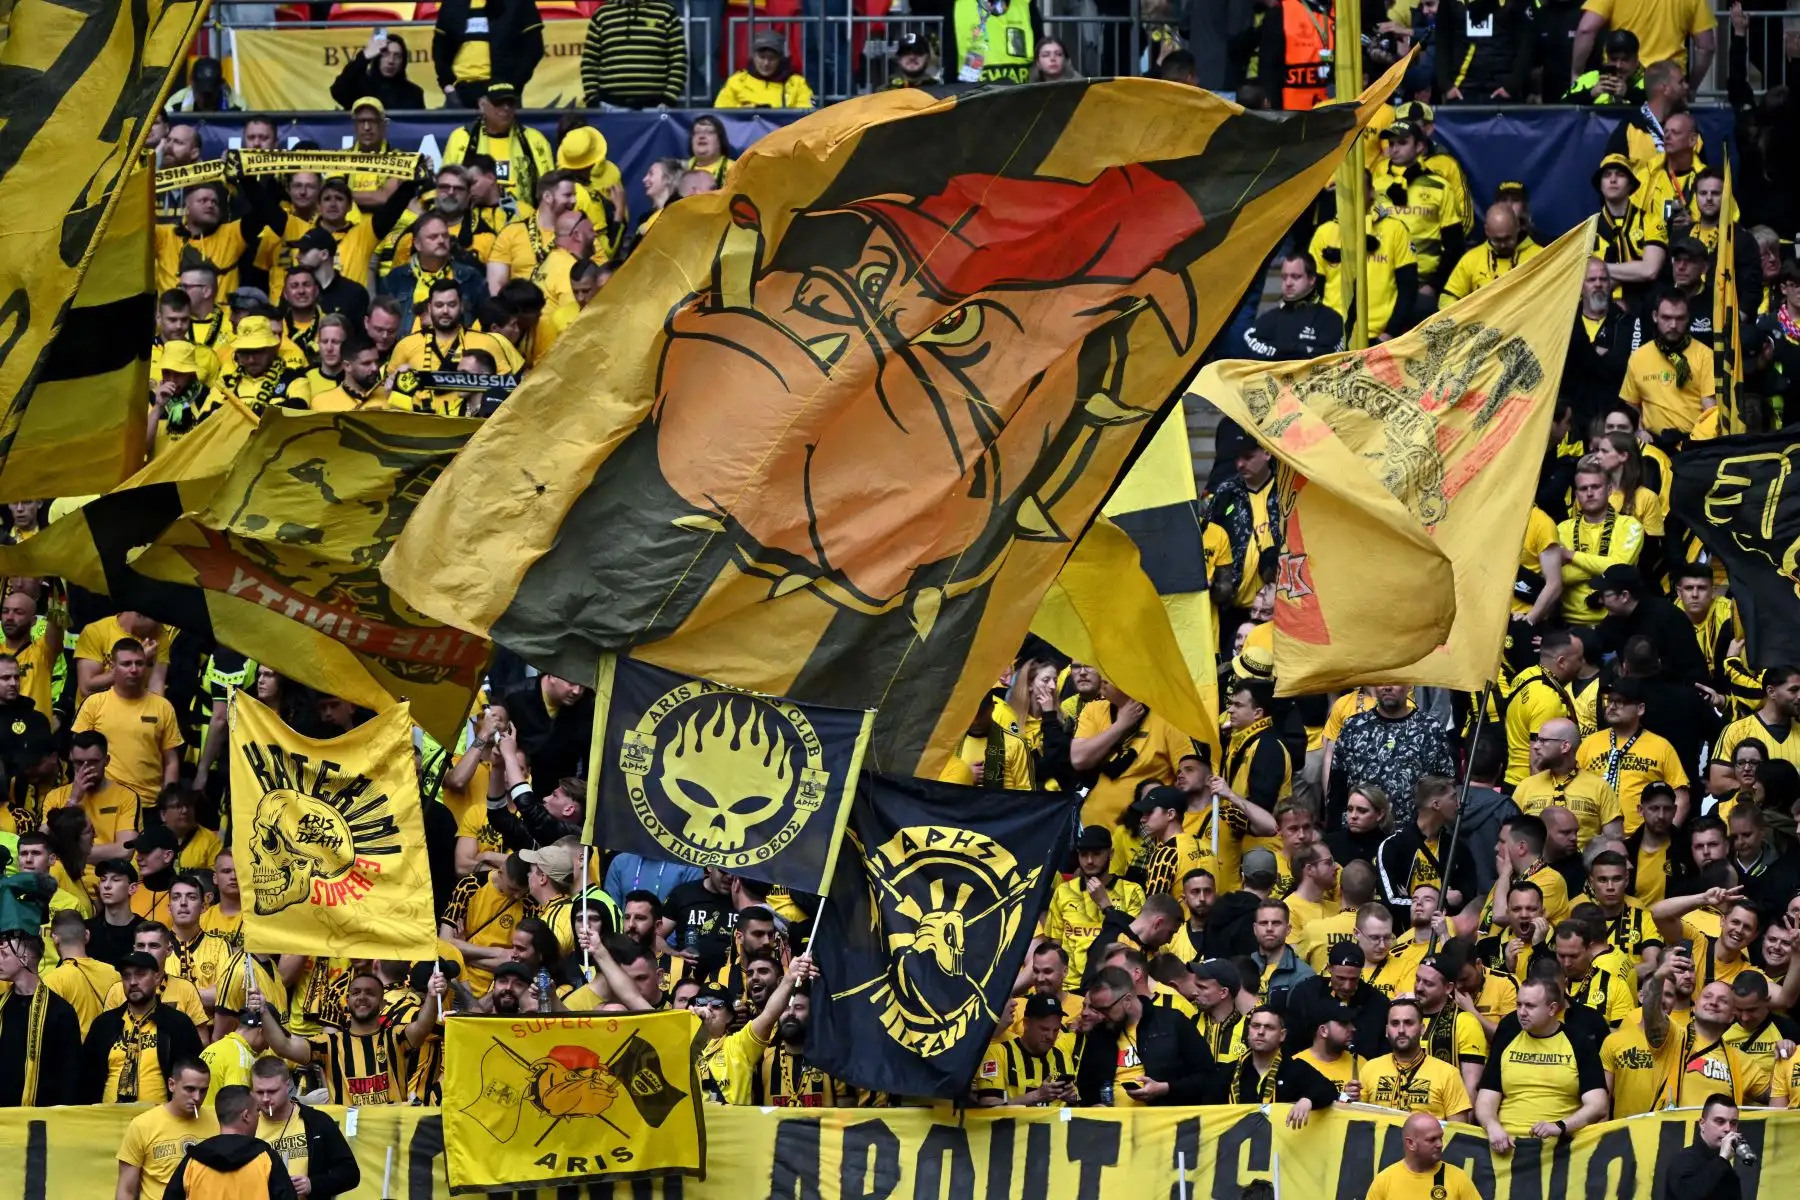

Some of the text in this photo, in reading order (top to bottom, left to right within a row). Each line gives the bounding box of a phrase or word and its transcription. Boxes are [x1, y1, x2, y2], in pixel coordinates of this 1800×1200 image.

[155, 167, 189, 184] SSIA
[432, 375, 517, 388] BORUSSIA
[648, 685, 693, 725] ARIS
[786, 707, 821, 758] CLUB
[298, 812, 336, 831] ARIS
[296, 833, 344, 852] DEATH
[511, 1016, 619, 1039] SUPER 3
[1540, 1053, 1573, 1064] UNITY
[533, 1145, 635, 1174] ARIS
